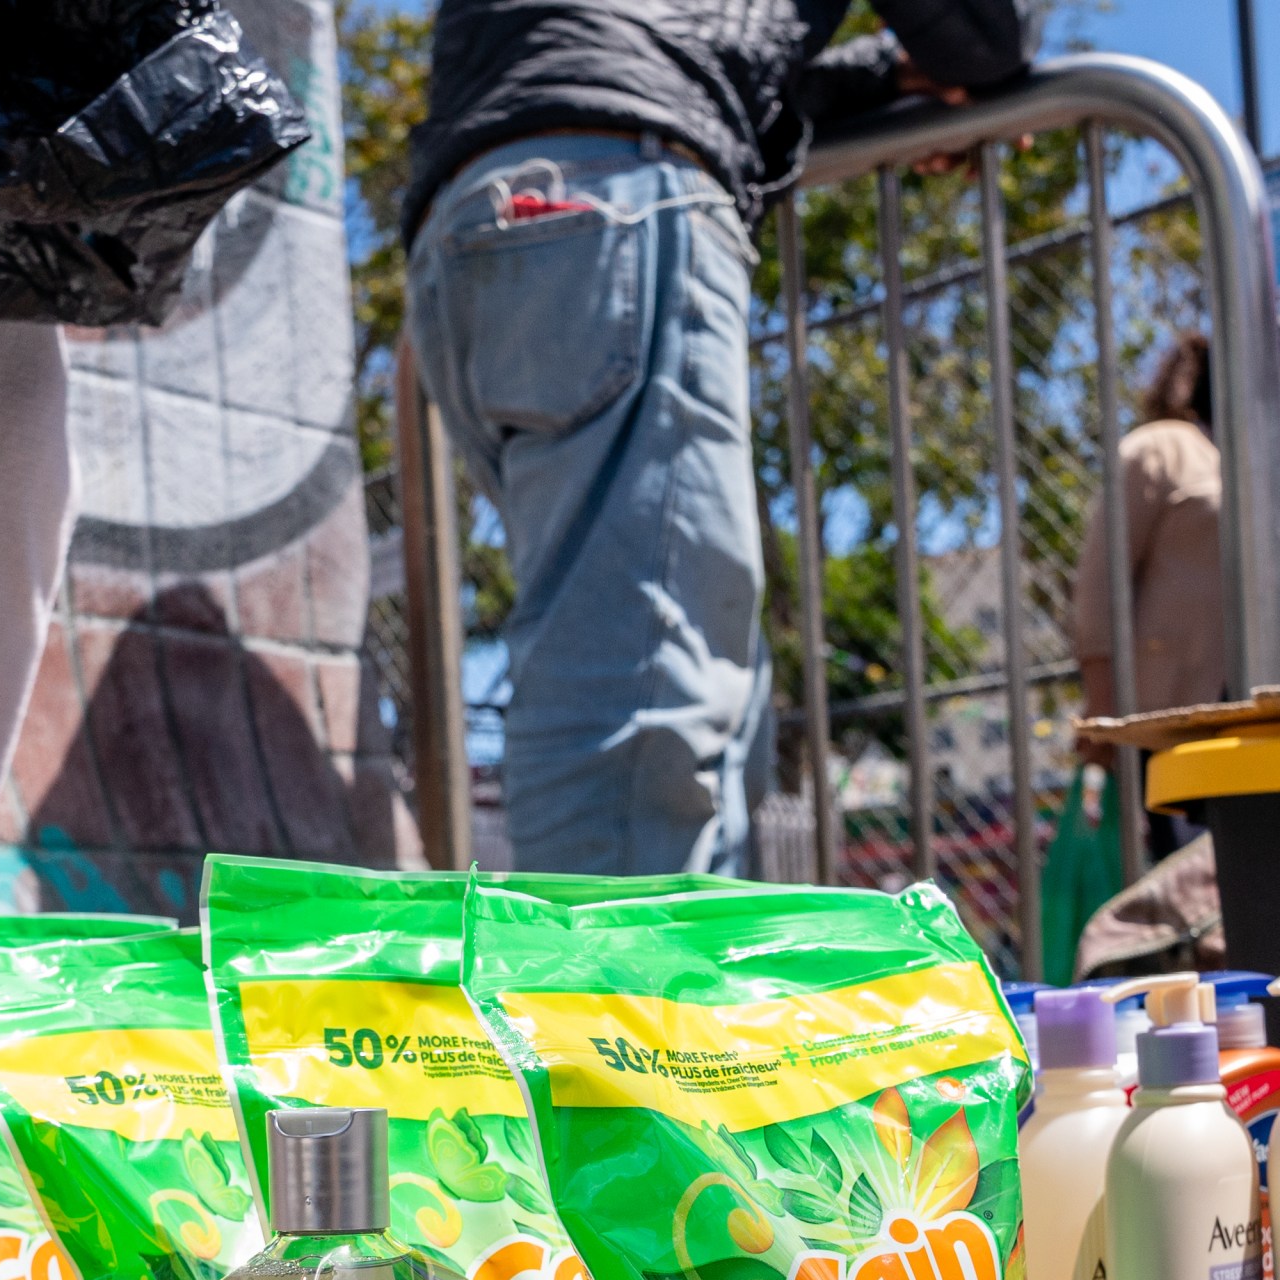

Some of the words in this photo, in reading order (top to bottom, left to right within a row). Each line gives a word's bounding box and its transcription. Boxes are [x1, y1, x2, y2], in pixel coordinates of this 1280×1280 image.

[323, 1028, 417, 1069] 50%
[418, 1036, 459, 1048] MORE
[421, 1051, 455, 1063] PLUS
[457, 1049, 476, 1062] de
[588, 1037, 669, 1078] 50%
[666, 1050, 701, 1063] MORE
[871, 1042, 888, 1054] en
[891, 1039, 916, 1051] eau
[671, 1066, 702, 1079] PLUS
[703, 1066, 719, 1079] de
[721, 1061, 778, 1077] fraîcheur
[65, 1071, 157, 1105] 50%
